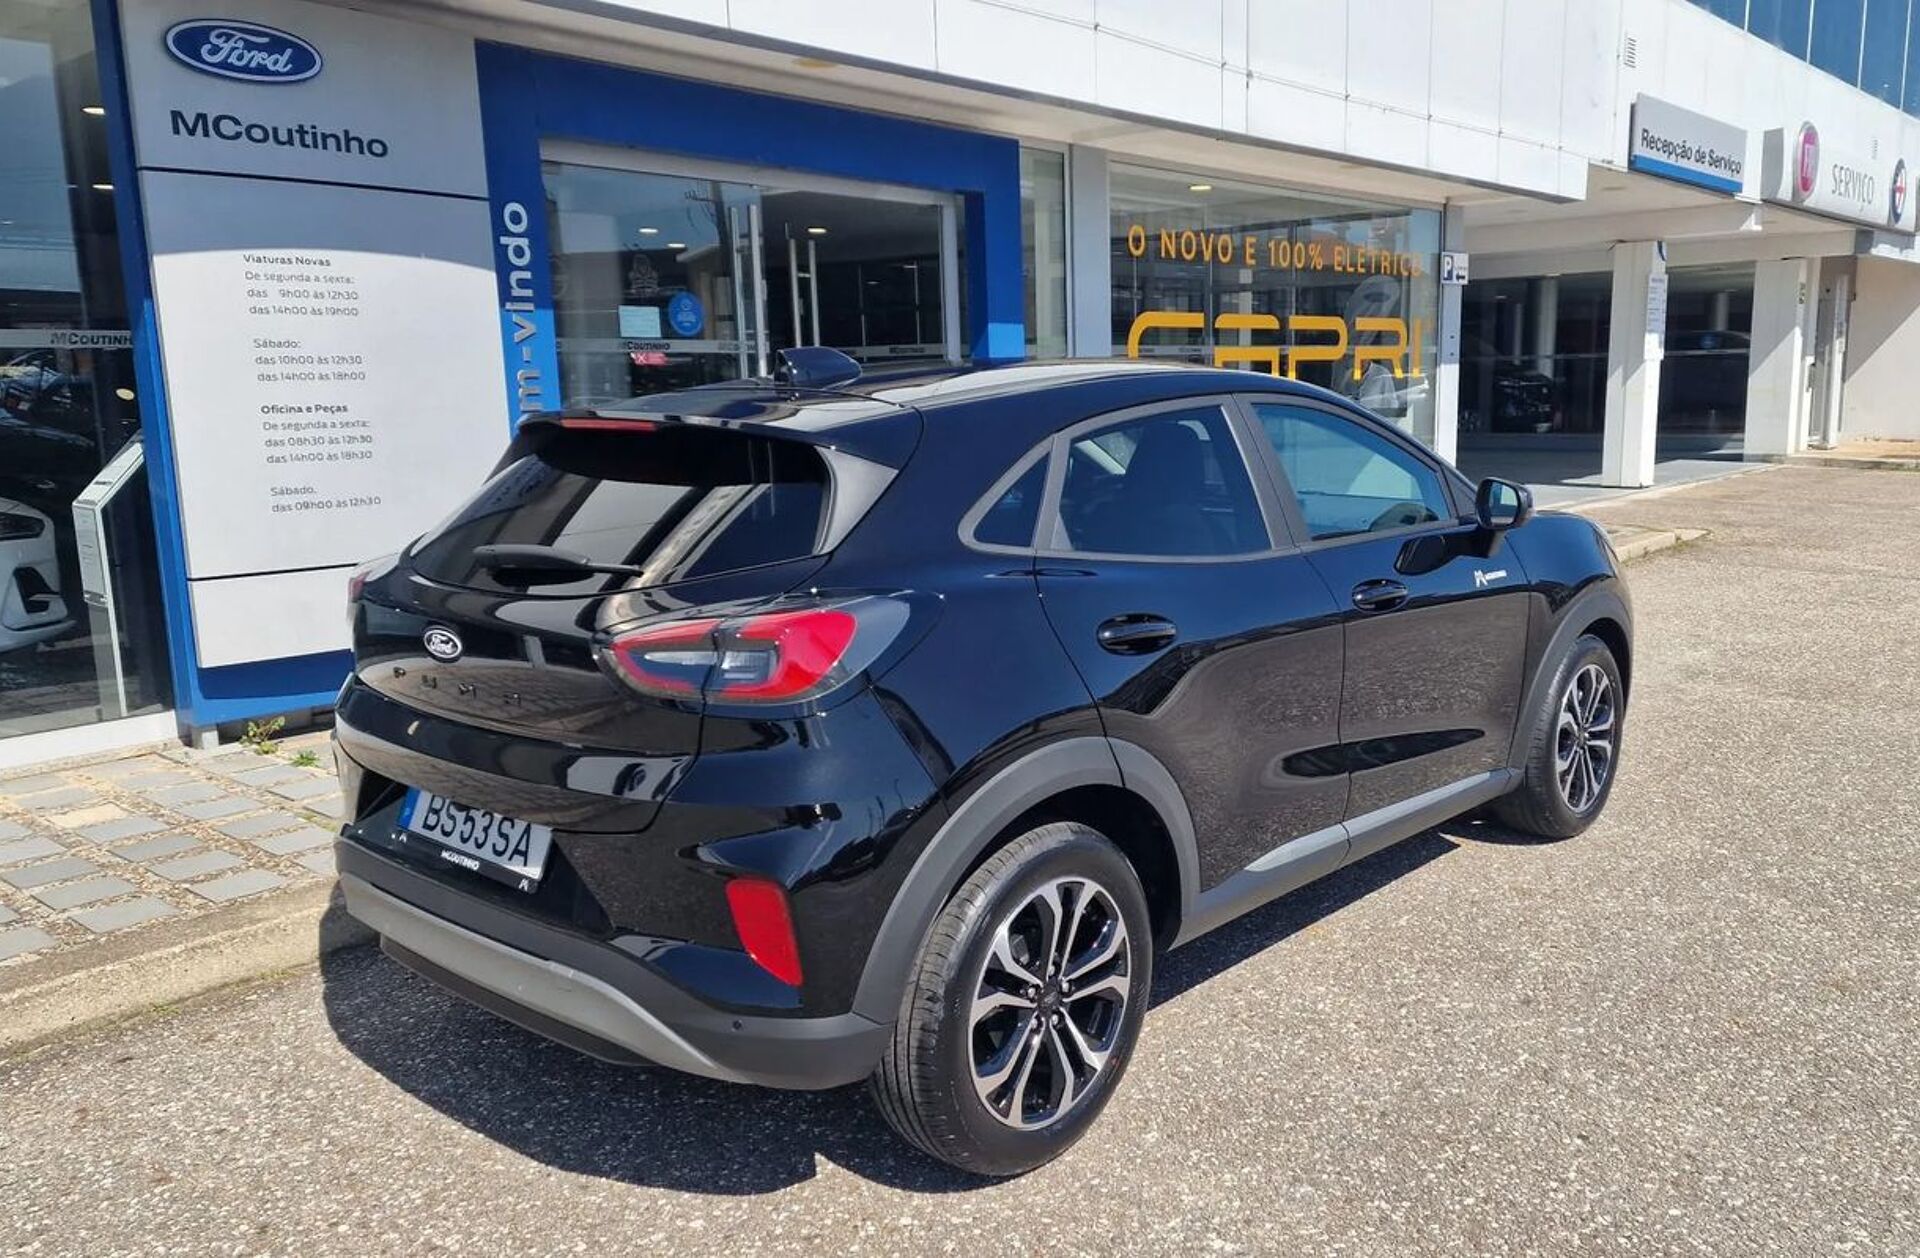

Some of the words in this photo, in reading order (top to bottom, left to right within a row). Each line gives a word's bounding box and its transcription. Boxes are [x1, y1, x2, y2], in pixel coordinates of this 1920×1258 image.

[200, 28, 292, 74] Ford
[169, 108, 389, 159] MCoutinho
[1641, 127, 1693, 165] Recepção
[1694, 144, 1706, 165] de
[1707, 149, 1742, 179] Serviço
[1831, 163, 1875, 212] SERVIÇO
[1127, 224, 1146, 258] O
[1160, 228, 1234, 264] NOVO
[1268, 240, 1323, 271] 100%
[243, 254, 293, 265] Viaturas
[295, 256, 331, 267] Novas
[1444, 256, 1452, 278] P
[245, 271, 261, 281] De
[263, 271, 311, 284] segunda
[247, 288, 268, 298] das
[279, 289, 310, 299] 9h00
[327, 290, 358, 300] 12h30
[249, 305, 270, 315] das
[272, 305, 307, 316] 14h00
[51, 332, 132, 347] MCOUTINH
[253, 338, 301, 349] Sábado:
[255, 355, 276, 365] das
[278, 355, 314, 365] 10h00
[331, 355, 363, 365] 12h30
[257, 372, 279, 382] das
[280, 371, 315, 382] 14h00
[260, 404, 304, 415] Oficina
[314, 404, 348, 415] Peças
[263, 421, 278, 431] De
[281, 420, 328, 432] segunda
[265, 438, 285, 448] das
[287, 436, 325, 447] 08h30
[342, 435, 373, 445] 12h30
[267, 454, 287, 464] das
[290, 453, 325, 463] 14h00
[272, 504, 293, 513] das
